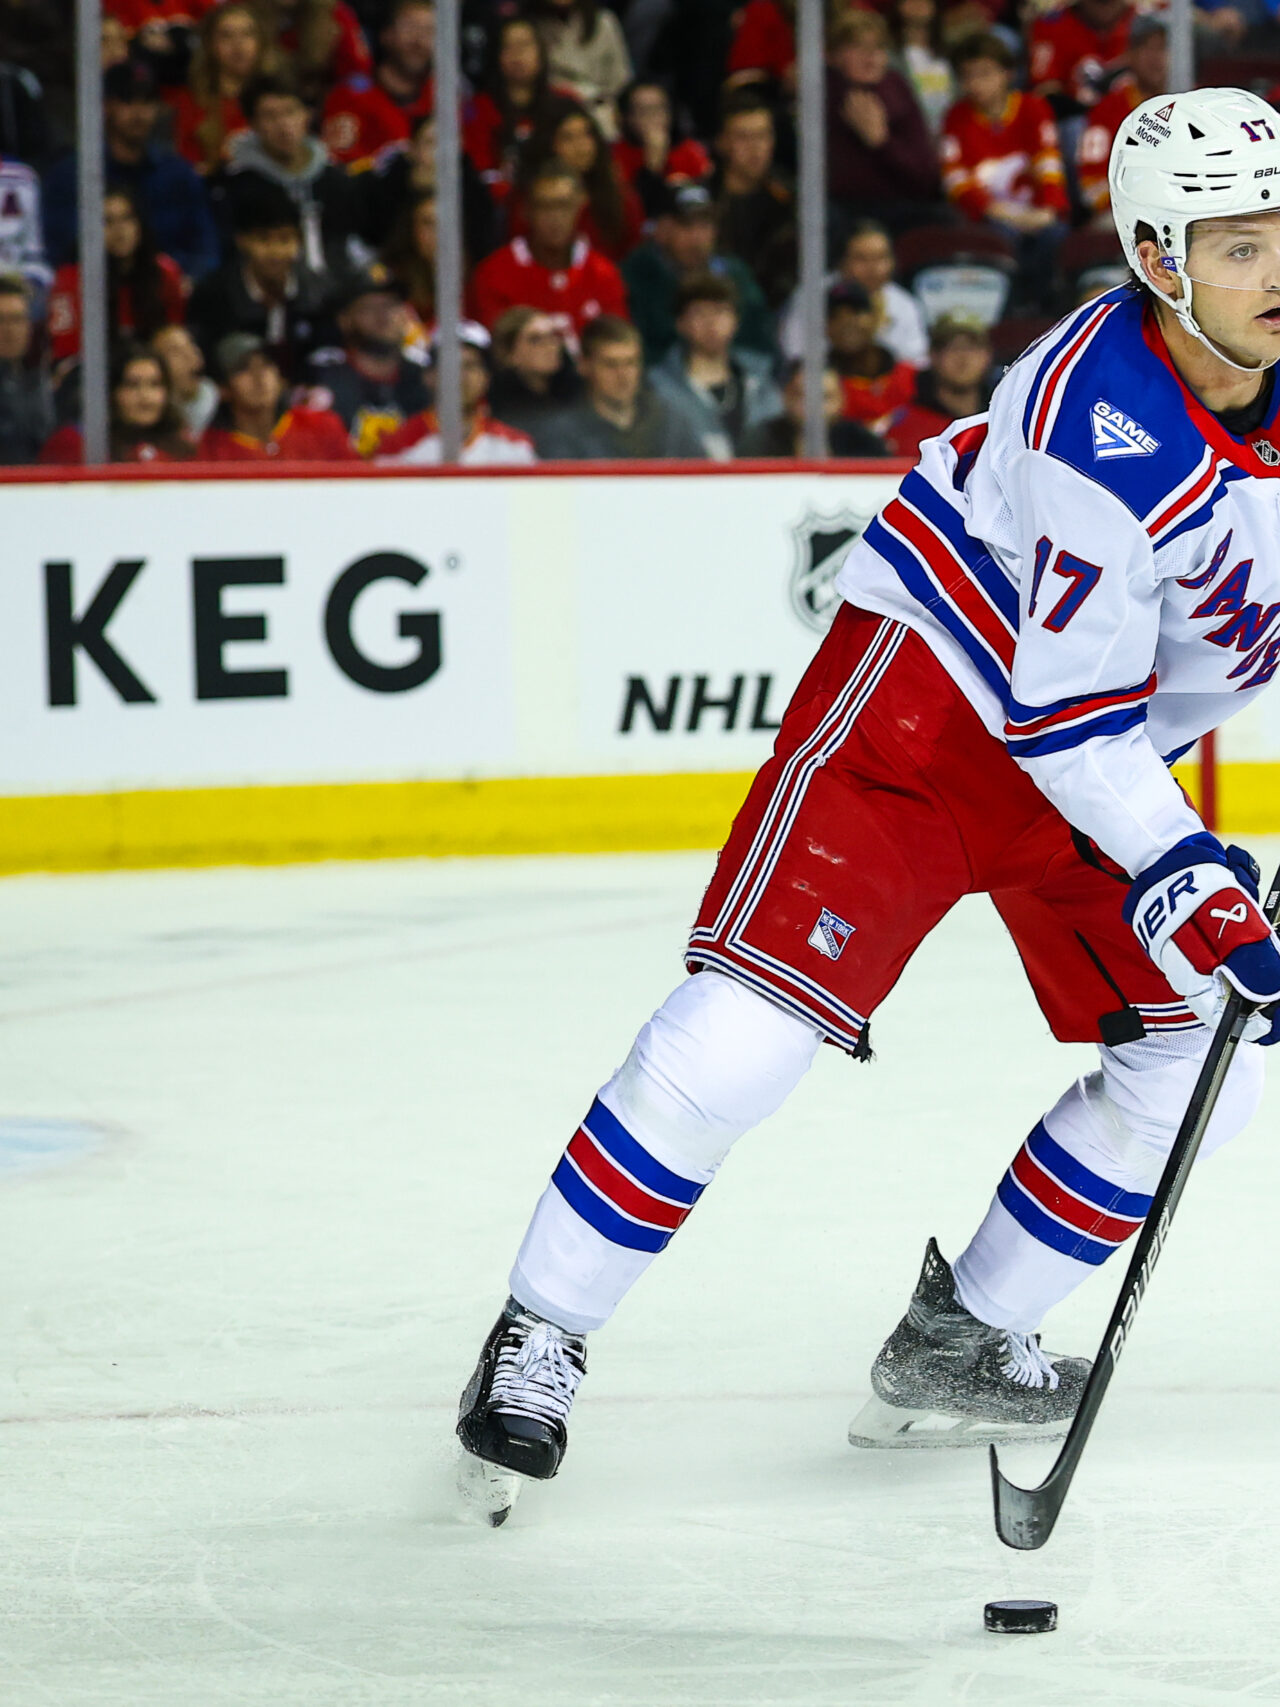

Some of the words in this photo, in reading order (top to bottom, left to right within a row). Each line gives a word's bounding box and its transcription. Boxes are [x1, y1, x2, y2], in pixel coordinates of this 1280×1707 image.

[1135, 125, 1160, 148] Moore
[1138, 112, 1172, 139] Benjamin
[1240, 119, 1275, 142] 17
[1093, 401, 1160, 454] GAME
[1028, 535, 1103, 633] 17
[43, 549, 443, 708] KEG
